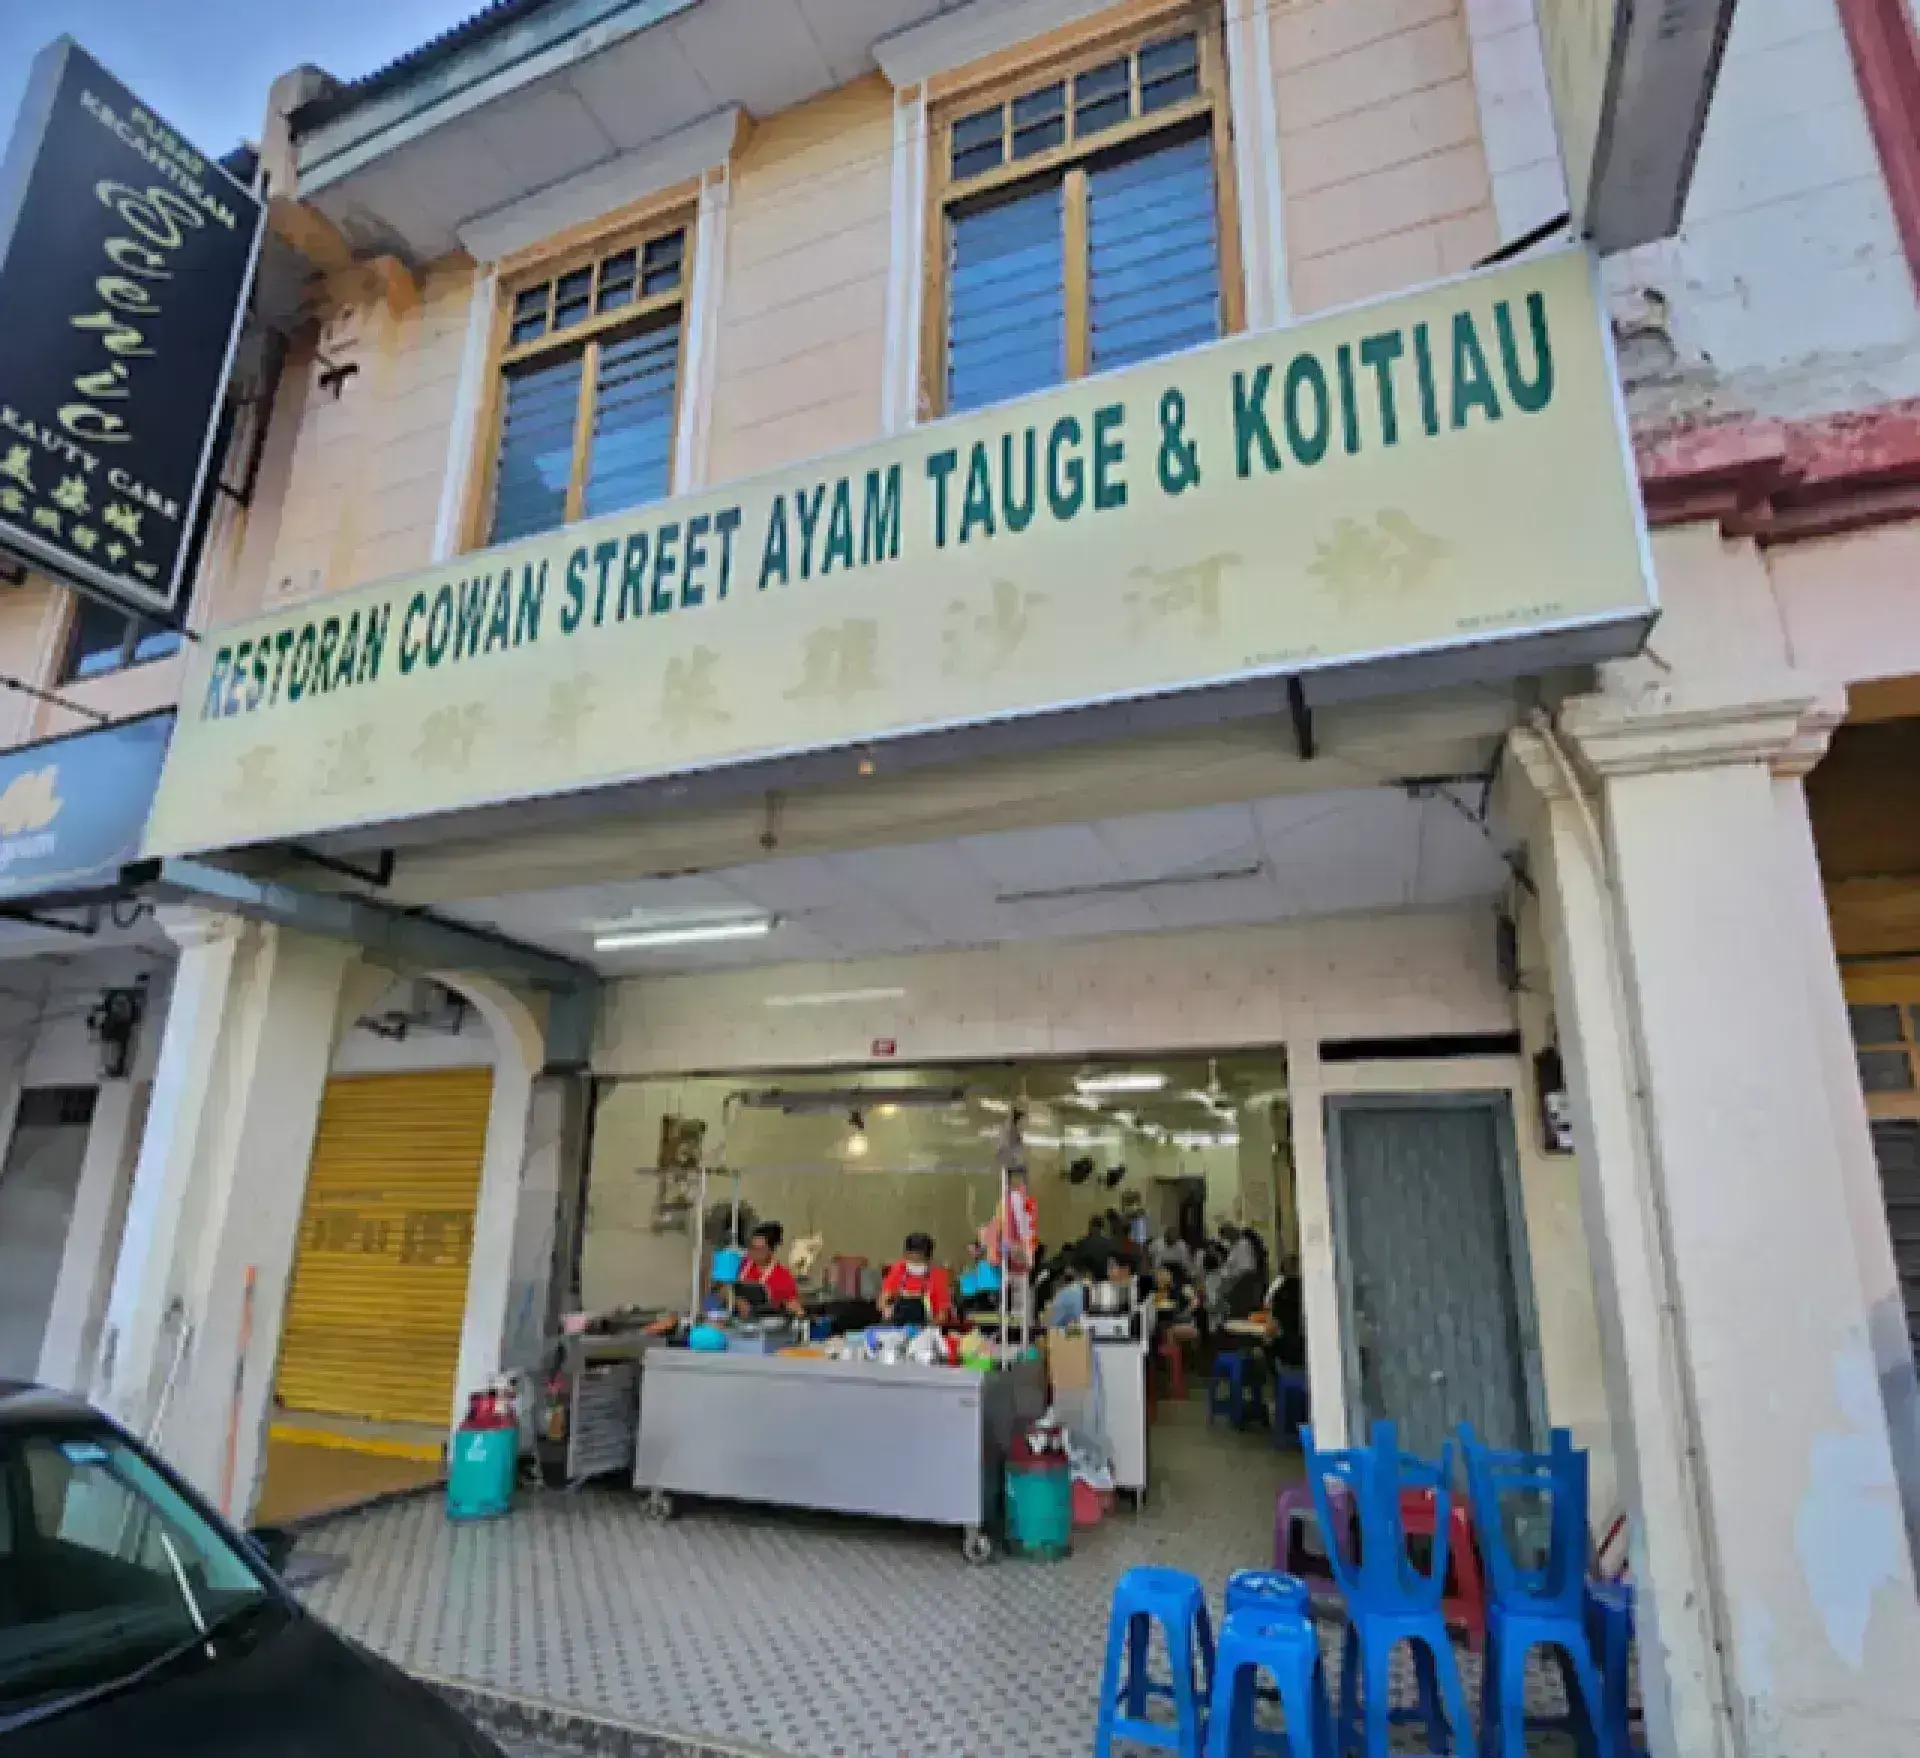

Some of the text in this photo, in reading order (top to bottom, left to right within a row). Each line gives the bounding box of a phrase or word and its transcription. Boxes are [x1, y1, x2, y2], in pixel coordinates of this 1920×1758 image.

[80, 88, 236, 229] KECANTIKAN
[201, 291, 1554, 721] RESTORAN COWAN STREET AYAM TAUGE & KOITIAU
